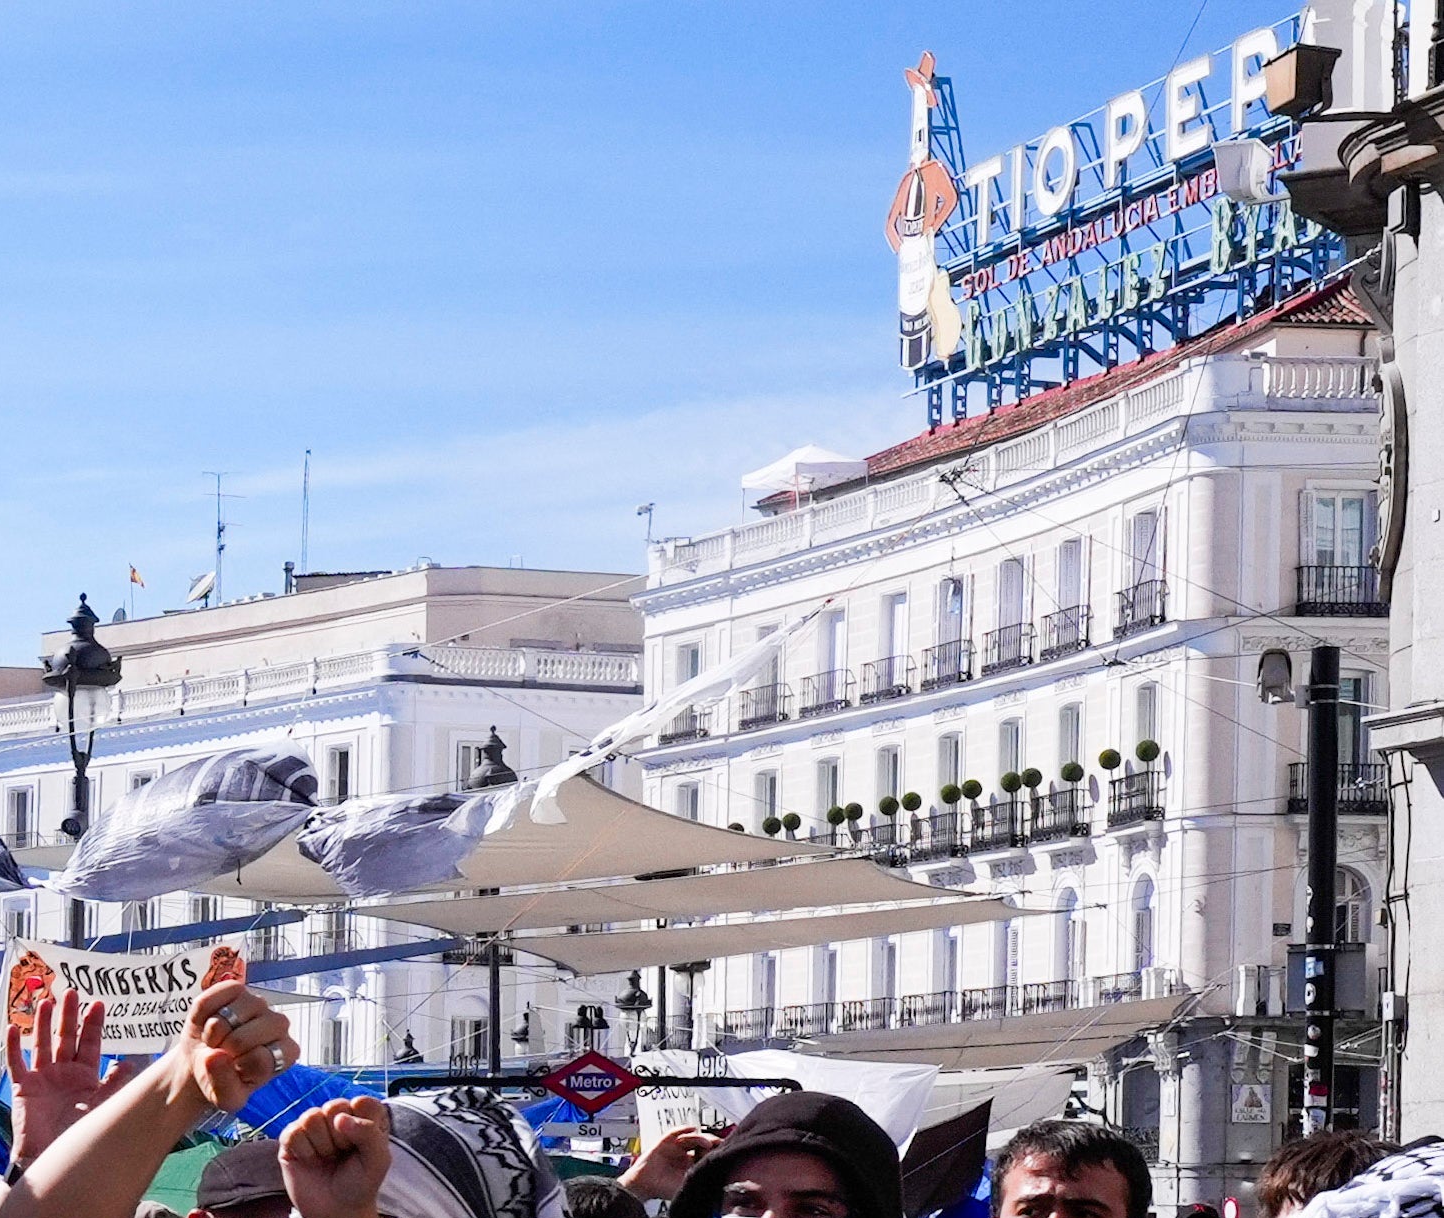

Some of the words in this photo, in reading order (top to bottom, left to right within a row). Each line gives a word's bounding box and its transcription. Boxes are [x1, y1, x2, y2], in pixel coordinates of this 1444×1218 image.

[964, 125, 1077, 247] TIO
[962, 263, 1002, 300] SOL
[1006, 249, 1035, 281] DE
[1041, 193, 1161, 268] ANDALUCIA
[964, 240, 1169, 370] GONZALEZ
[59, 957, 198, 997] BOMBERXS
[106, 1001, 130, 1018] LOS
[125, 1026, 136, 1040] NI
[139, 1019, 185, 1037] EJECUTO
[449, 1054, 480, 1078] 1919
[697, 1053, 729, 1078] 1919
[570, 1076, 613, 1089] Metro
[578, 1124, 603, 1137] Sol
